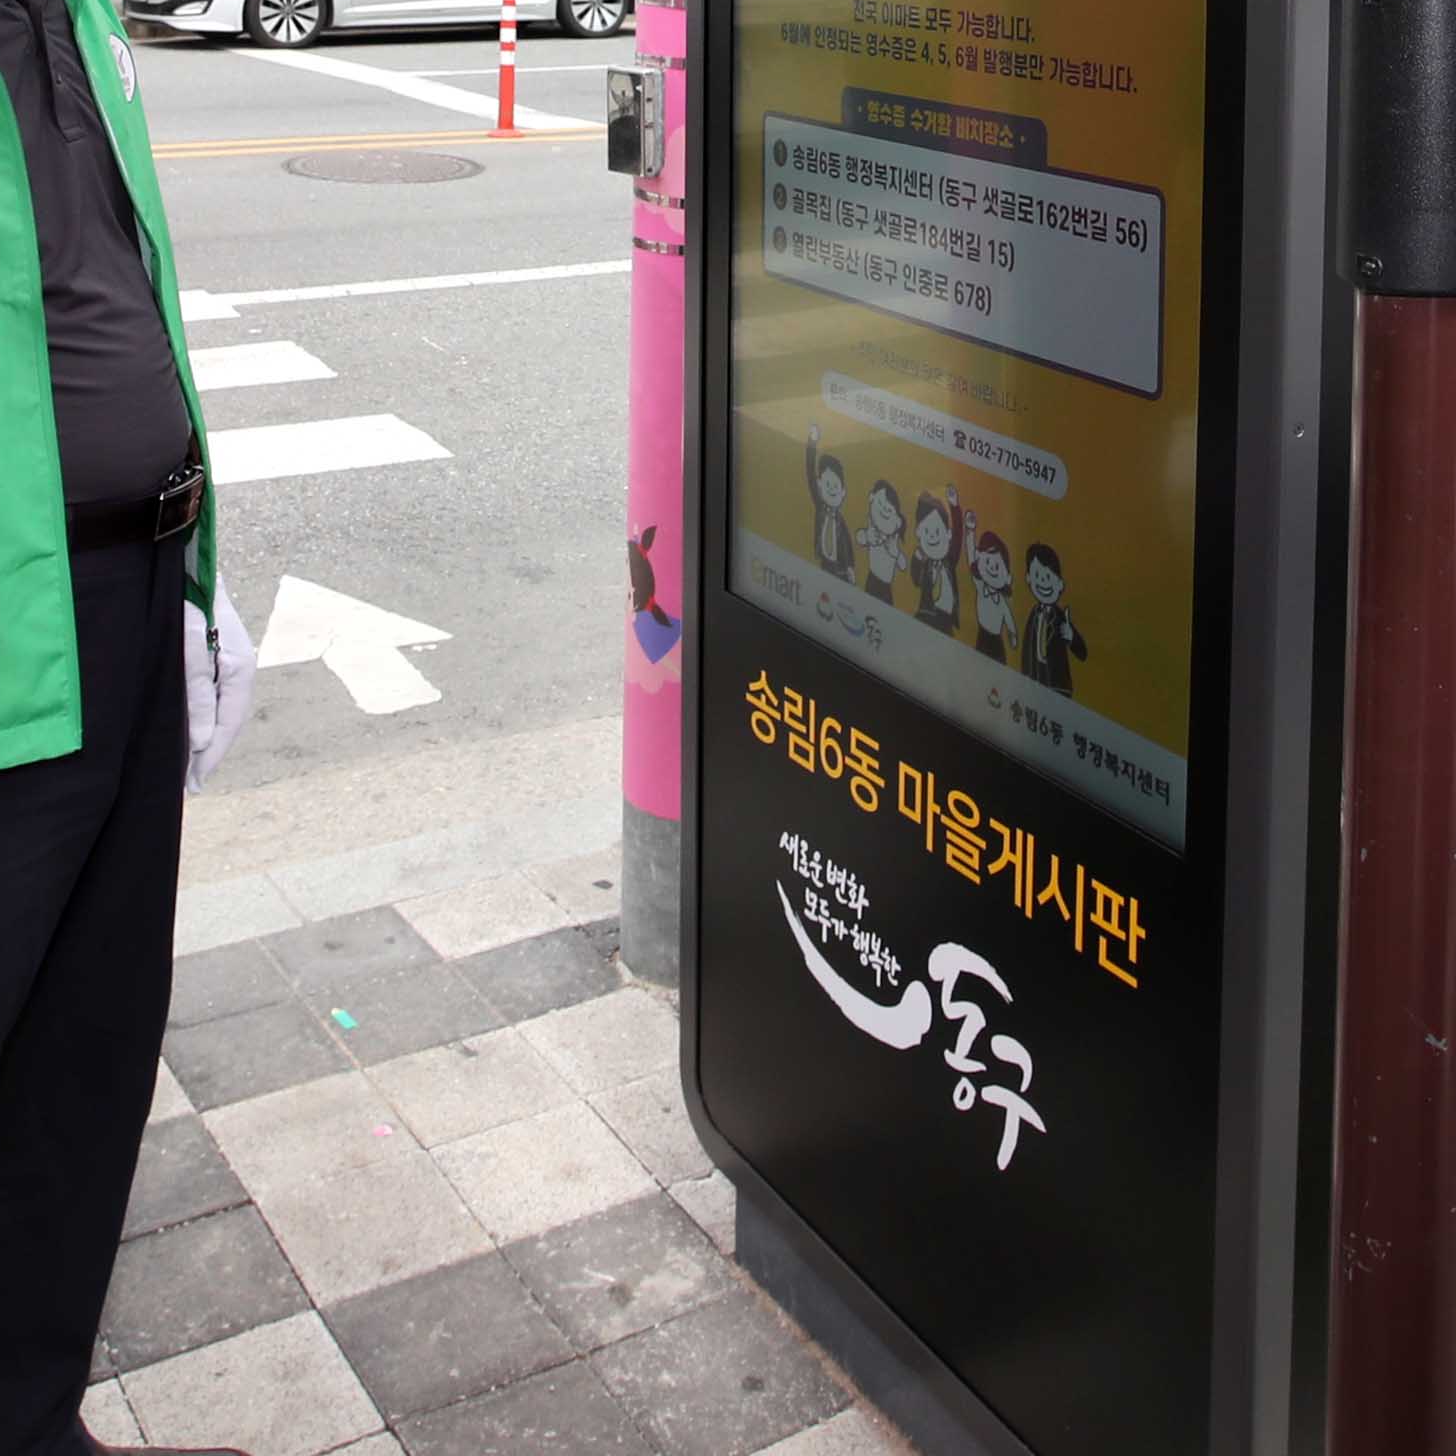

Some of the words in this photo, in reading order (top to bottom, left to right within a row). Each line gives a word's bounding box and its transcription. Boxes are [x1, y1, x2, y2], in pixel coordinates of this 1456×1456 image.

[853, 0, 878, 24] 전국
[882, 2, 921, 30] 이마트
[925, 7, 953, 32] 모두
[957, 10, 1035, 44] 가능합니다.
[866, 32, 918, 63] 영수증은
[955, 45, 979, 73] 6월
[984, 47, 1044, 81] 발행분만
[1049, 57, 1138, 93] 가능합니다.
[792, 187, 832, 223] 골목집
[836, 198, 870, 231] (동구
[874, 208, 981, 263] 샛골로184번길
[987, 239, 1016, 273] 15)
[793, 144, 841, 179] 송림6동
[845, 155, 934, 201] 행정복지센터
[939, 175, 978, 212] (동구
[983, 186, 1108, 243] 샛골로162번길
[1115, 216, 1149, 254] 56)
[792, 231, 860, 276] 열린부동산
[864, 251, 898, 287] (동구
[902, 263, 950, 301] 인중로
[953, 280, 992, 317] 678)
[968, 437, 1057, 485] 032-770-5947
[745, 669, 886, 814] 송림6동
[897, 758, 1146, 989] 마을게시판
[779, 831, 824, 888] 새로운
[826, 859, 870, 921] 변화
[803, 887, 849, 943] 모두가
[849, 923, 902, 987] 행복한
[928, 943, 1047, 1170] 동구
